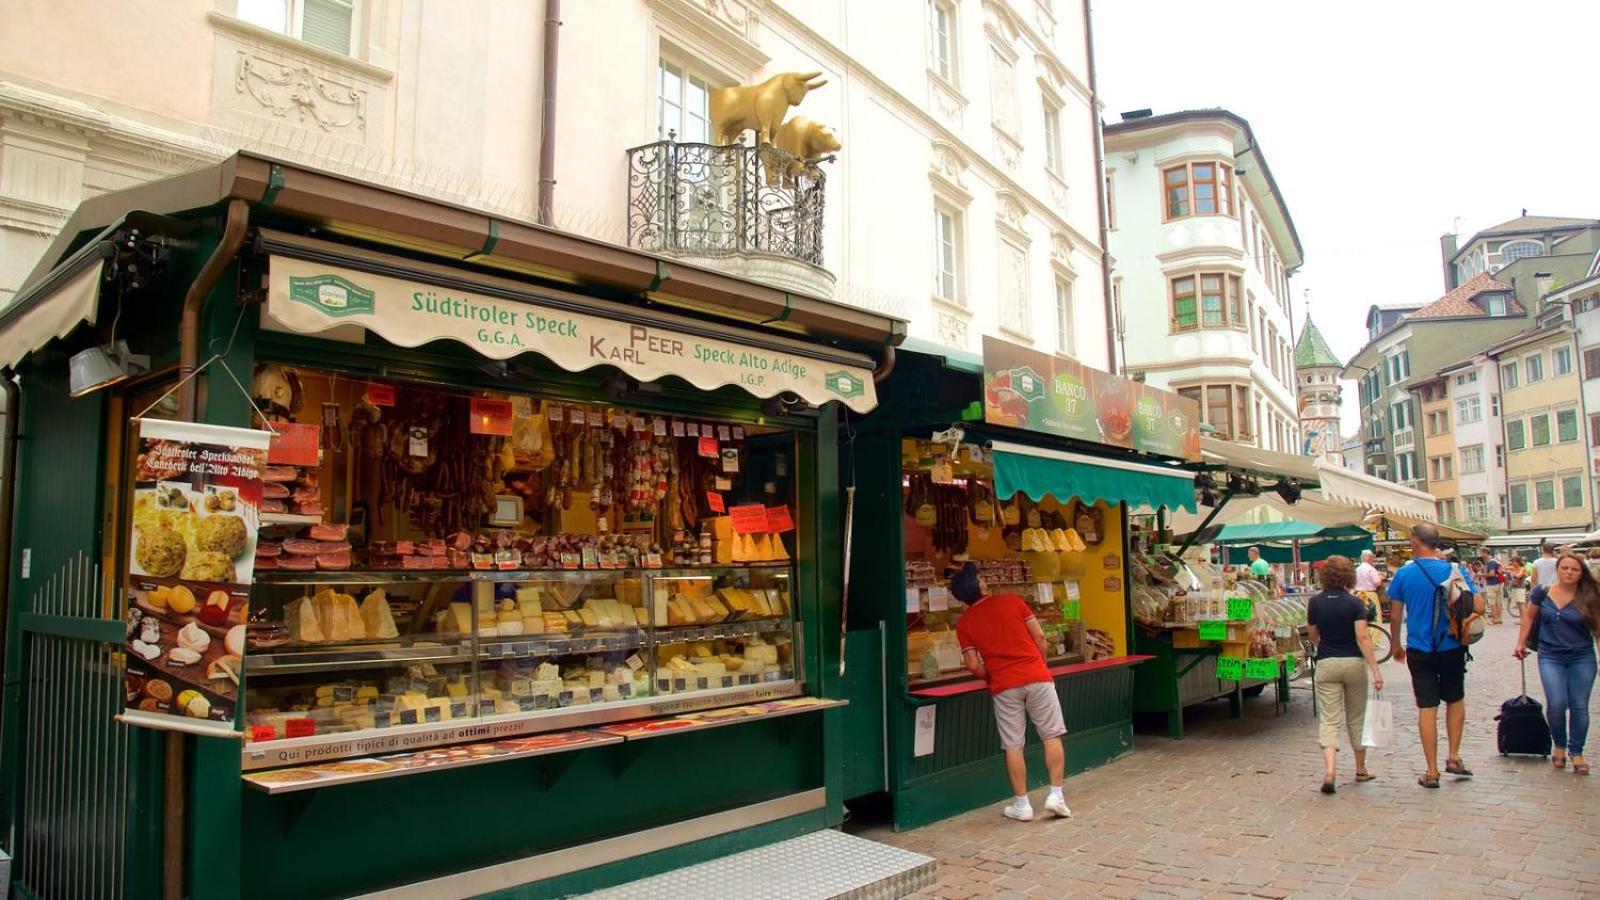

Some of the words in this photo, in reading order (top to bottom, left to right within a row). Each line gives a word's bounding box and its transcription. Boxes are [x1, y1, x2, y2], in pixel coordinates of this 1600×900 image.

[411, 292, 518, 326] Südtiroler
[525, 311, 578, 338] Speck
[477, 329, 526, 347] G.G.A.
[590, 335, 646, 365] KARL
[630, 325, 684, 357] PEER
[693, 343, 735, 365] Speck
[739, 353, 768, 370] Alto
[771, 358, 807, 379] Adige
[740, 372, 767, 387] I.G.P.
[1055, 378, 1086, 401] BANCO
[1064, 397, 1076, 414] 37
[1138, 400, 1162, 419] BANCO
[278, 750, 300, 761] Qui
[304, 743, 352, 760] prodotti
[356, 738, 384, 751] tipici
[388, 737, 399, 748] di
[402, 732, 439, 746] qualità
[442, 730, 455, 740] ad
[458, 724, 490, 738] ottimi
